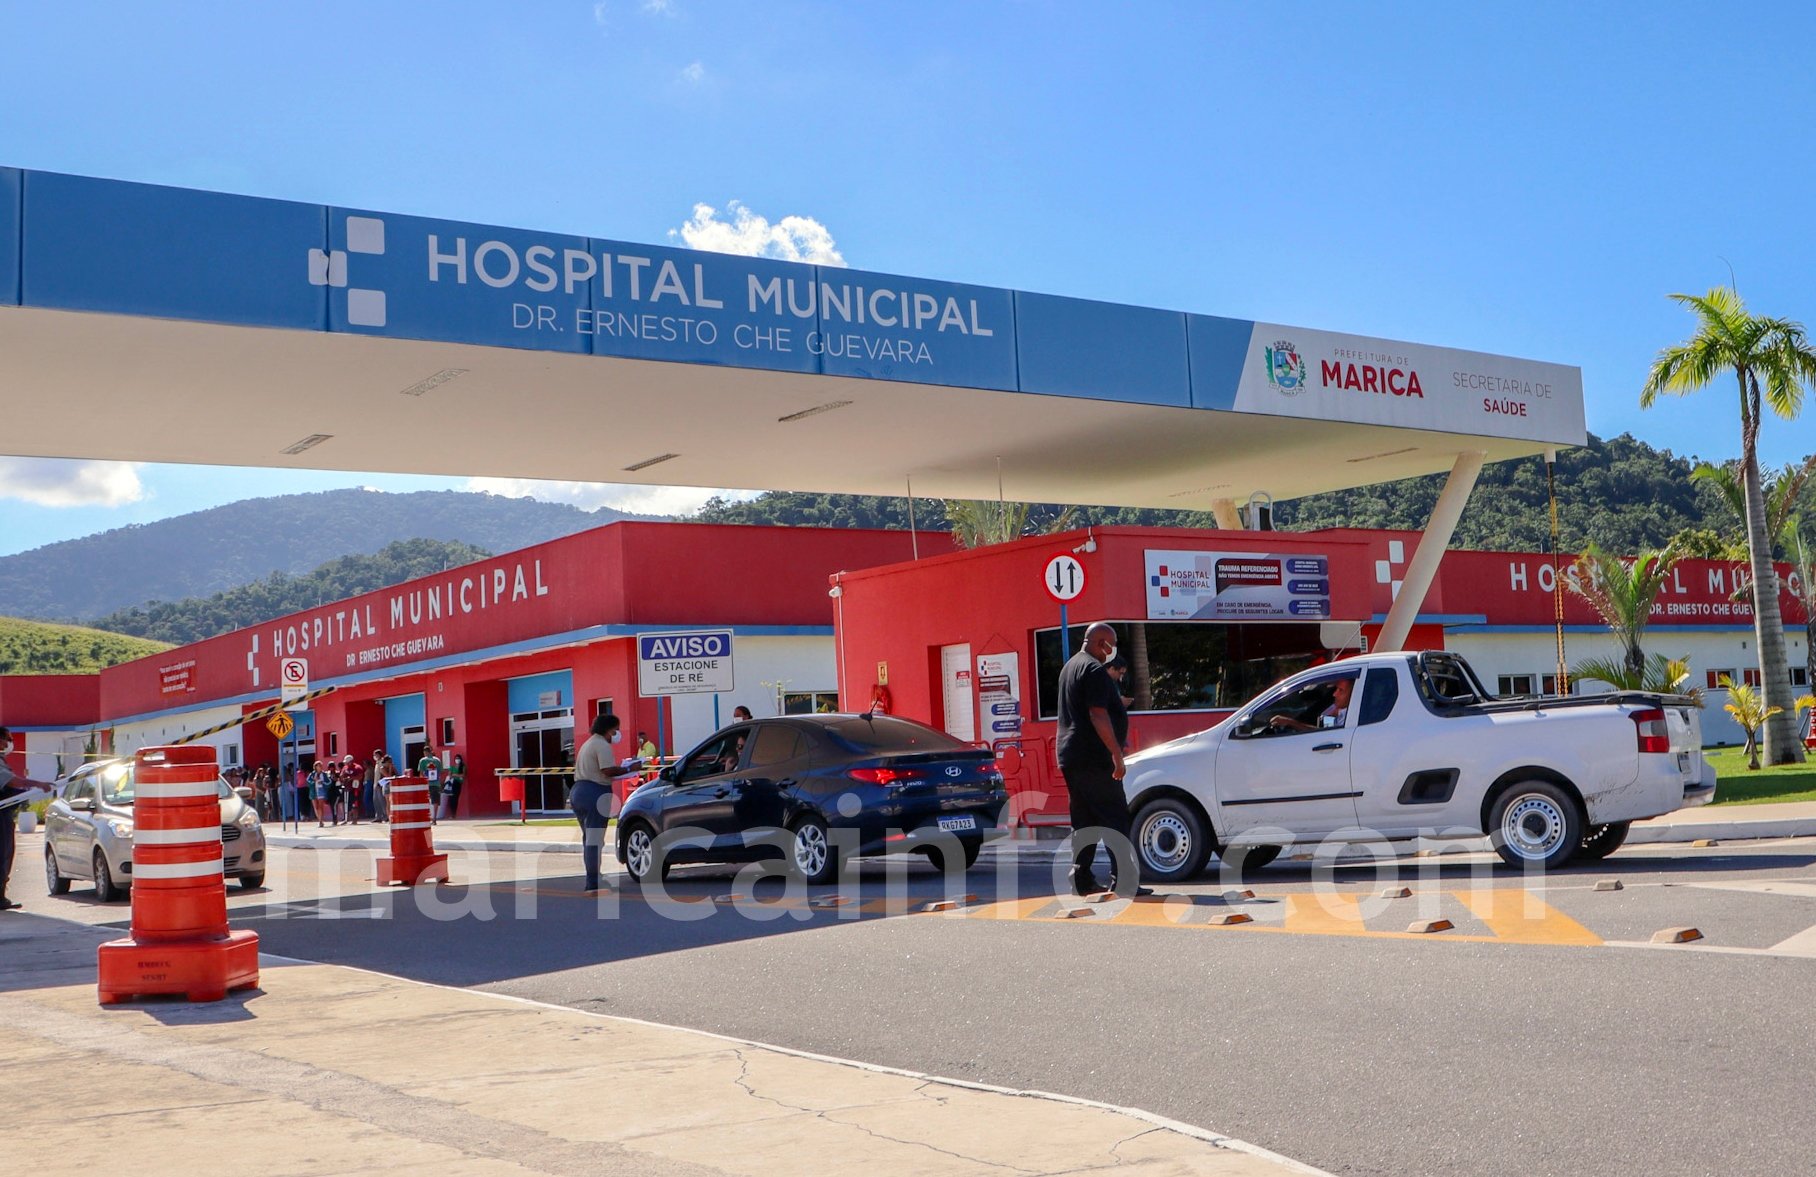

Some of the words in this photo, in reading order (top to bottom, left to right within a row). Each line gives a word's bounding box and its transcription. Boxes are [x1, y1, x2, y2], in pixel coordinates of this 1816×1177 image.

[428, 234, 723, 309] HOSPITAL
[748, 274, 993, 337] MUNICIPAL
[513, 303, 563, 332] DR.
[576, 308, 717, 345] ERNESTO
[734, 324, 792, 351] CHE
[806, 331, 933, 365] GUEVARA
[1334, 348, 1393, 364] PREFEITURA
[1397, 356, 1409, 366] DE
[1452, 371, 1532, 396] SECRETARIA
[1535, 383, 1552, 399] DE
[1484, 396, 1527, 417] SAÚDE
[1170, 570, 1210, 579] HOSPITAL
[1218, 564, 1240, 572] TRAUMA
[1240, 565, 1278, 573] REFERENCIADO
[1171, 580, 1210, 589] MUNICIPAL
[273, 604, 376, 658] HOSPITAL
[391, 559, 548, 629] MUNICIPAL
[1650, 603, 1665, 615] DR.
[1668, 603, 1709, 615] ERNESTO
[1712, 603, 1730, 615] CHE
[359, 646, 391, 665] ERNESTO
[391, 642, 406, 659] CHE
[407, 634, 444, 655] GUEVARA
[650, 636, 722, 658] AVISO
[654, 660, 718, 672] ESTACIONE
[670, 674, 685, 683] DE
[688, 671, 704, 682] RÉ
[941, 820, 972, 830] RKG7A23
